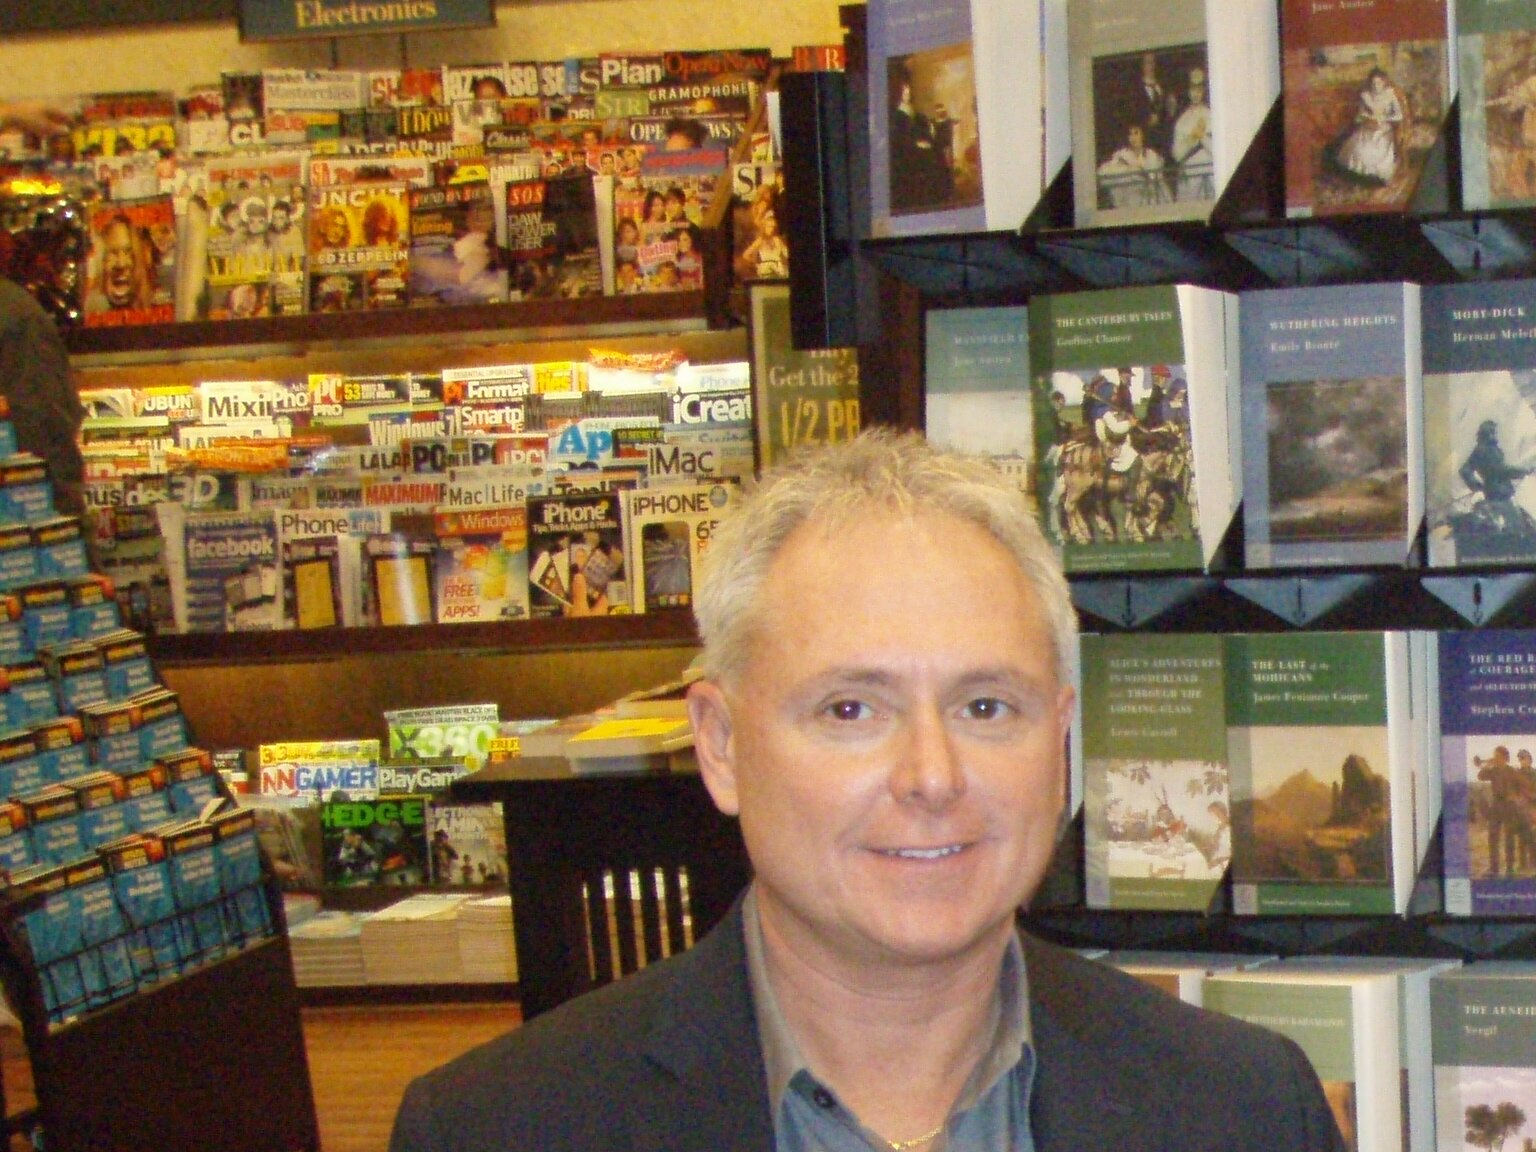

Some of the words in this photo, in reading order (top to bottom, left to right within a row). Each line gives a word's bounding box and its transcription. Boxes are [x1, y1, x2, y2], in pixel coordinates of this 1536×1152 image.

[296, 0, 437, 28] Electronics
[511, 182, 545, 206] SOS
[509, 223, 557, 240] POWER
[1452, 305, 1527, 321] MOBY-DICK
[1056, 317, 1076, 328] THE
[1269, 317, 1339, 331] WUTHERING
[1343, 313, 1398, 328] HEIGHTS
[1452, 329, 1497, 344] Herman
[769, 365, 806, 387] Get
[543, 500, 604, 524] iPhone
[281, 513, 348, 534] Phone
[461, 512, 524, 529] Windows
[188, 534, 273, 557] facebook
[444, 583, 475, 598] FREE
[1251, 660, 1276, 671] THE
[1278, 659, 1307, 671] LAST
[1469, 651, 1496, 665] THE
[1498, 651, 1524, 665] RED
[1124, 672, 1199, 684] WONDERLAND
[1252, 672, 1314, 684] MOHICANS
[1127, 688, 1178, 699] THROUGH
[1180, 688, 1202, 699] THE
[1253, 691, 1282, 704] James
[1284, 690, 1331, 703] Fenimore
[1332, 689, 1371, 704] Cooper
[1470, 703, 1515, 719] Stephen
[1110, 726, 1138, 739] Lewis
[1140, 726, 1178, 739] Carroll
[296, 767, 377, 792] GAMER
[1464, 1004, 1491, 1016] THE
